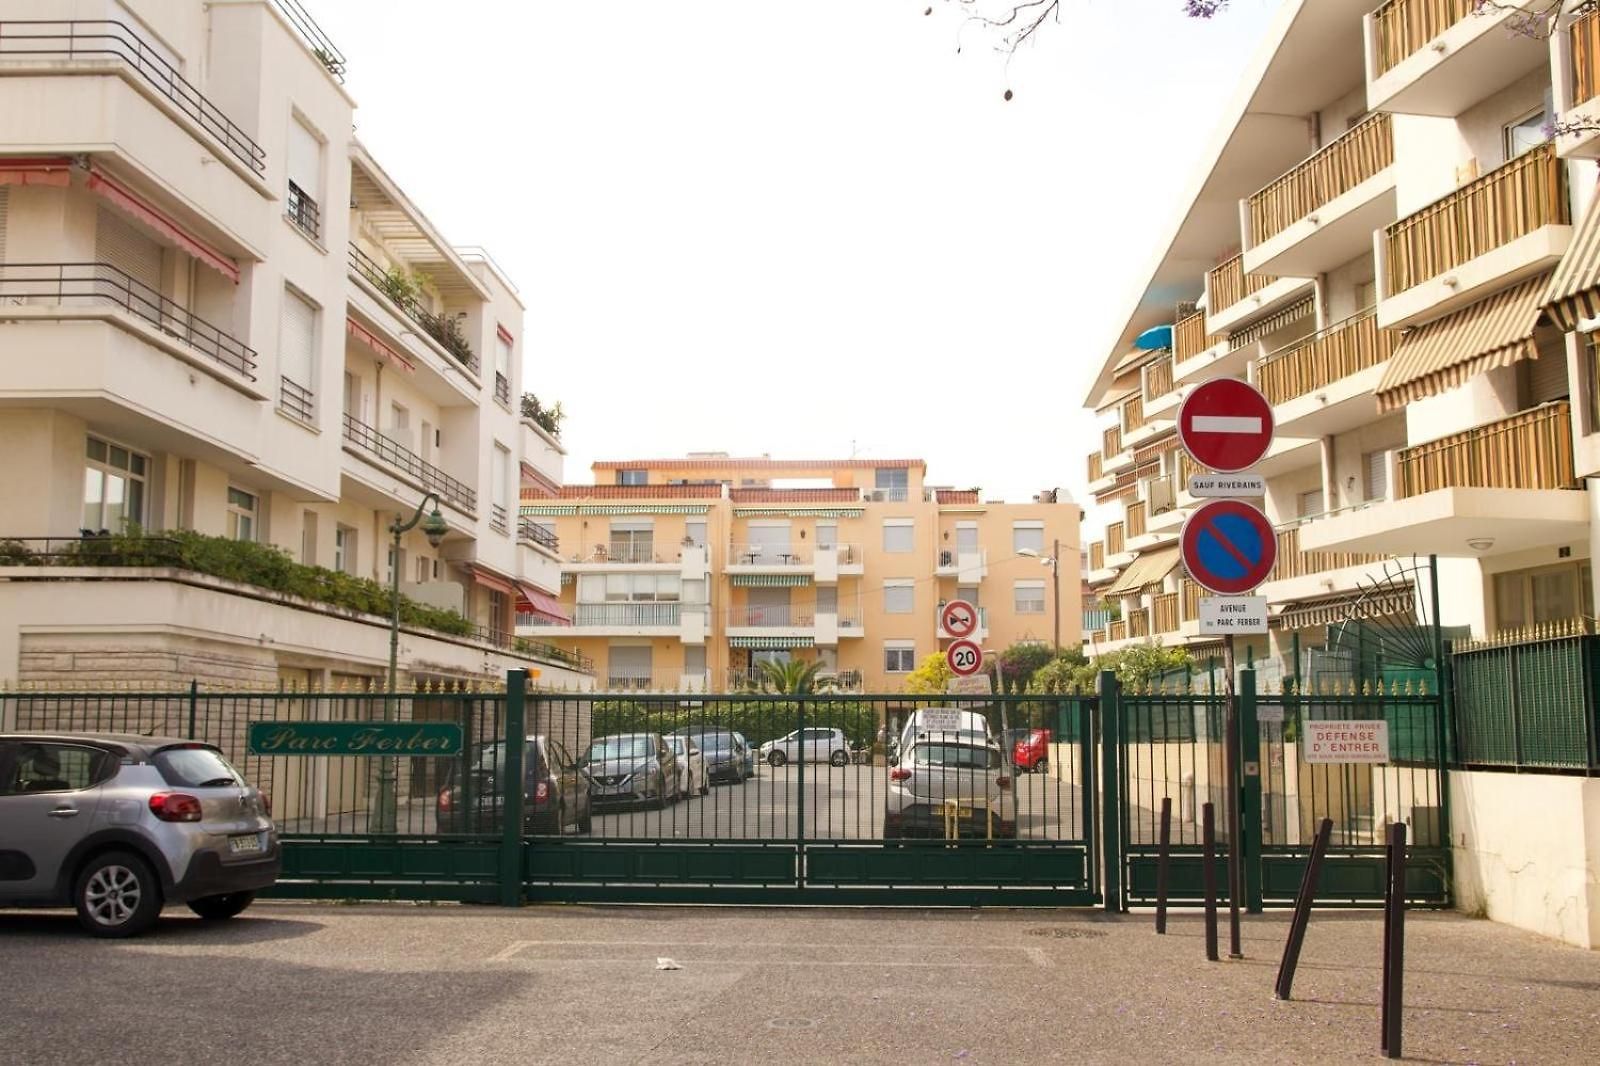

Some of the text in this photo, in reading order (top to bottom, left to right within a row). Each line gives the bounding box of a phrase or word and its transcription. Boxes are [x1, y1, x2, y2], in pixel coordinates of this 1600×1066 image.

[1194, 481, 1262, 489] SAUF RIVERAINS
[1220, 604, 1247, 613] AVENUE
[1217, 618, 1234, 627] PARC
[1237, 618, 1261, 626] FERBER
[955, 650, 976, 667] 20
[260, 726, 450, 751] Parc Ferber
[1316, 732, 1376, 741] DEFENSE
